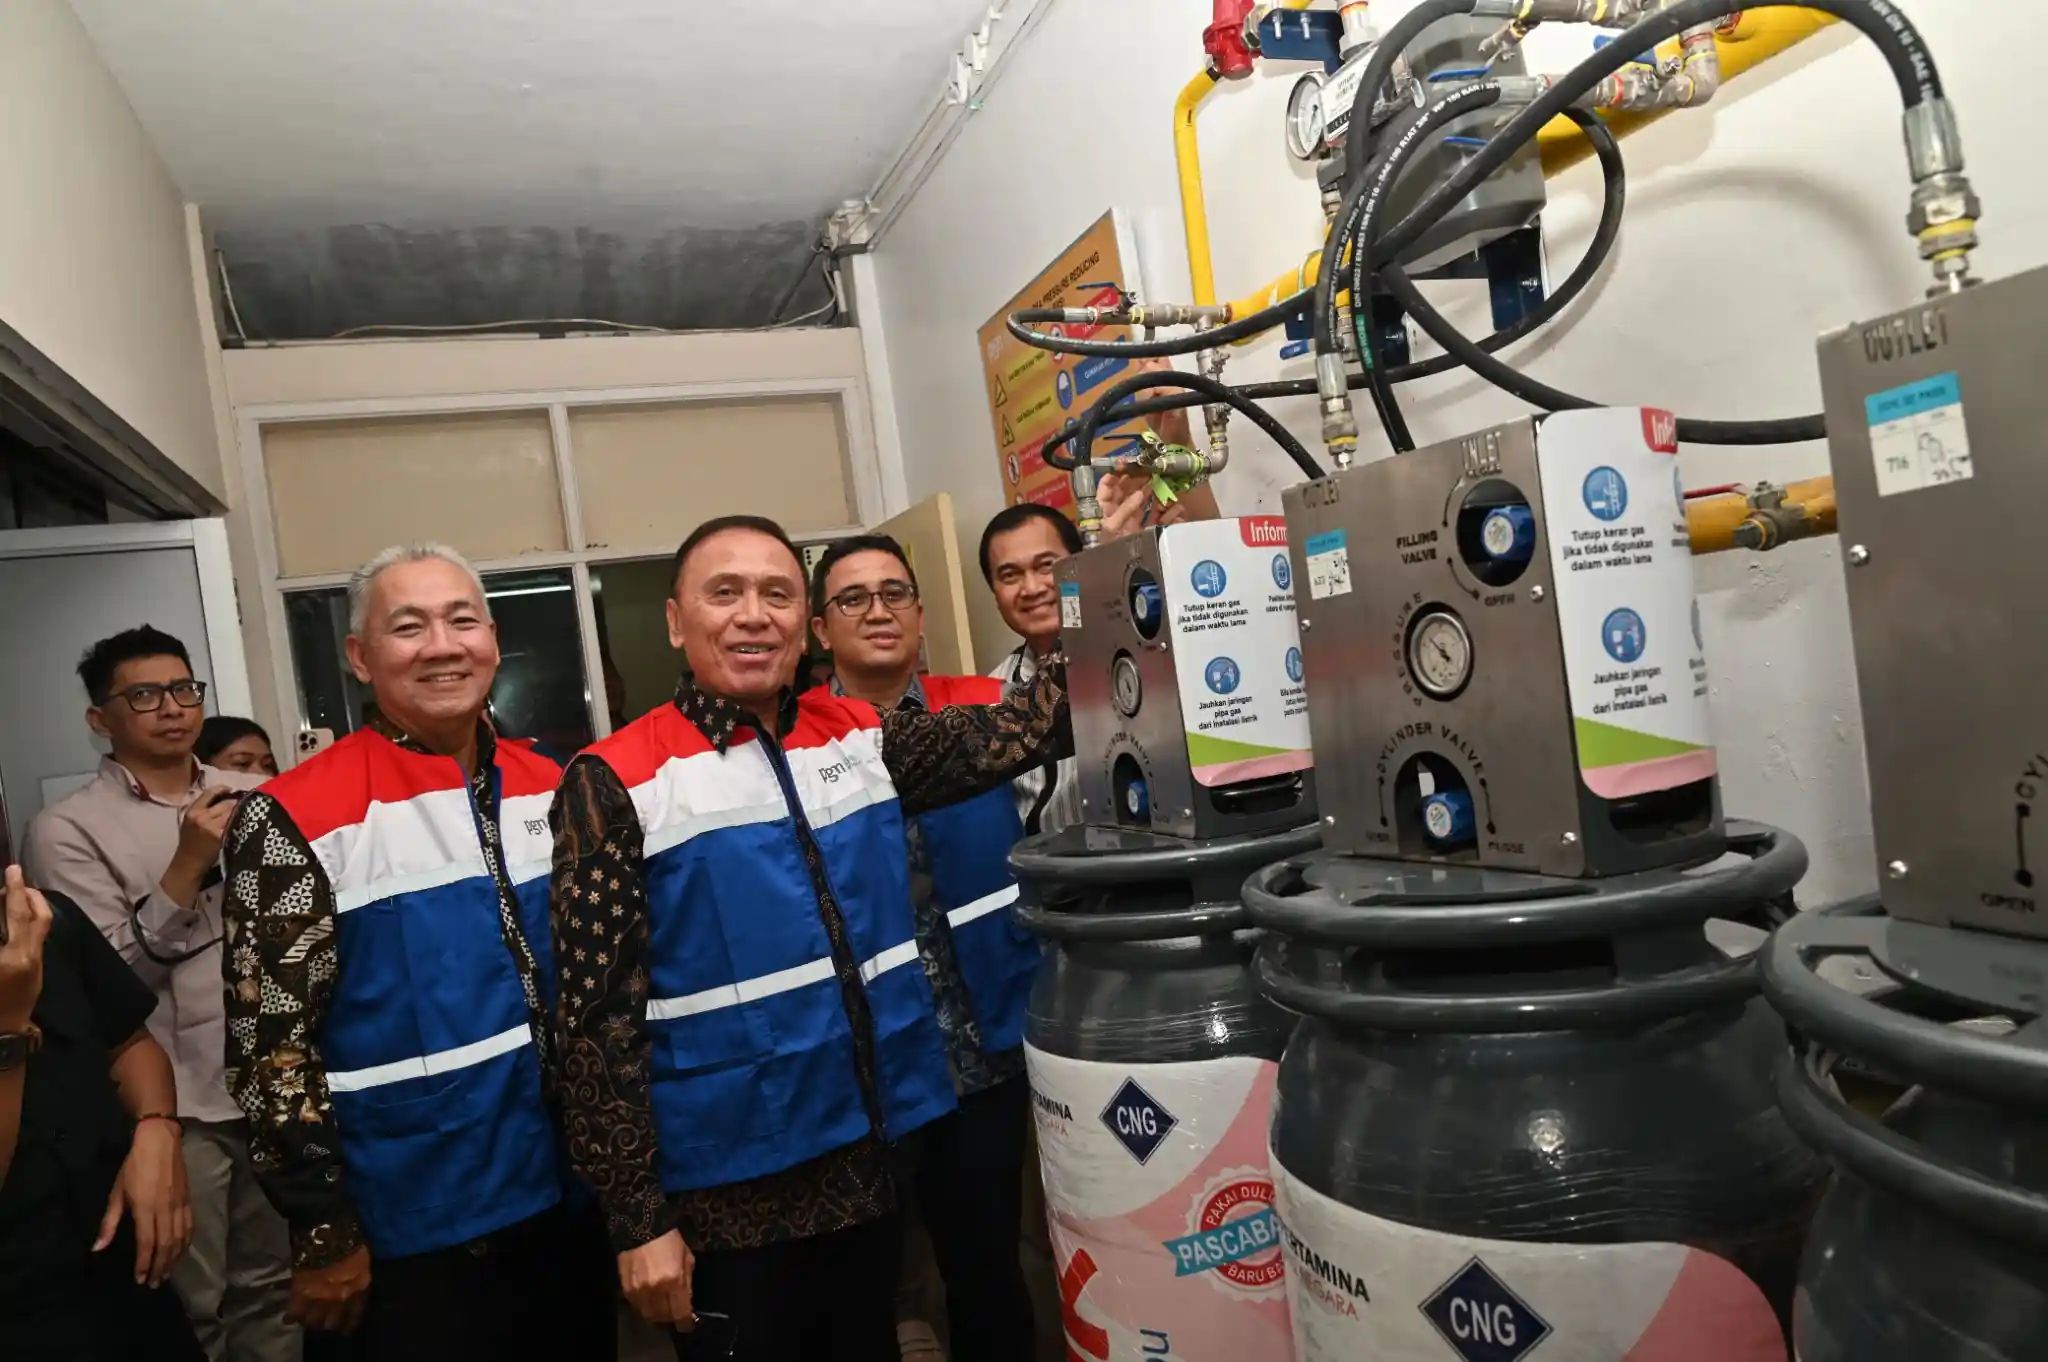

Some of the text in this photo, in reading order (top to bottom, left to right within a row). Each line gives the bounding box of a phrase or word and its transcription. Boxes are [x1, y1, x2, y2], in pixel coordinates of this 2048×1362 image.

[1461, 84, 1479, 96] BAR
[1070, 251, 1100, 280] REDUCING
[1863, 306, 1948, 363] OUTLET
[1461, 432, 1501, 469] INLET
[1396, 530, 1438, 548] FILLING
[1571, 526, 1644, 541] Tutup keran gas
[1584, 543, 1609, 554] tidak
[1612, 540, 1653, 553] digunakan
[1401, 548, 1437, 564] VALVE
[1571, 554, 1652, 571] dalam waktu lama
[1183, 599, 1241, 613] Tutup keran gas
[1192, 612, 1211, 622] tidak
[1213, 608, 1249, 619] digunakan
[1183, 618, 1246, 633] dalam waktu lama
[1593, 667, 1662, 684] Jauhkan jaringan
[1614, 684, 1648, 698] pipa gas
[1199, 696, 1253, 710] Jauhkan jaringan
[1593, 693, 1668, 714] dari instalasi listrik
[1214, 707, 1241, 718] pipa gas
[1198, 714, 1258, 730] dari instalasi listrik
[1377, 722, 1484, 775] CYLINDER VALVE
[818, 762, 847, 783] pgn
[1116, 1105, 1156, 1136] CNG
[1206, 1190, 1239, 1226] PAKAI
[1227, 1264, 1264, 1282] BARU
[1449, 1296, 1516, 1347] CNG
